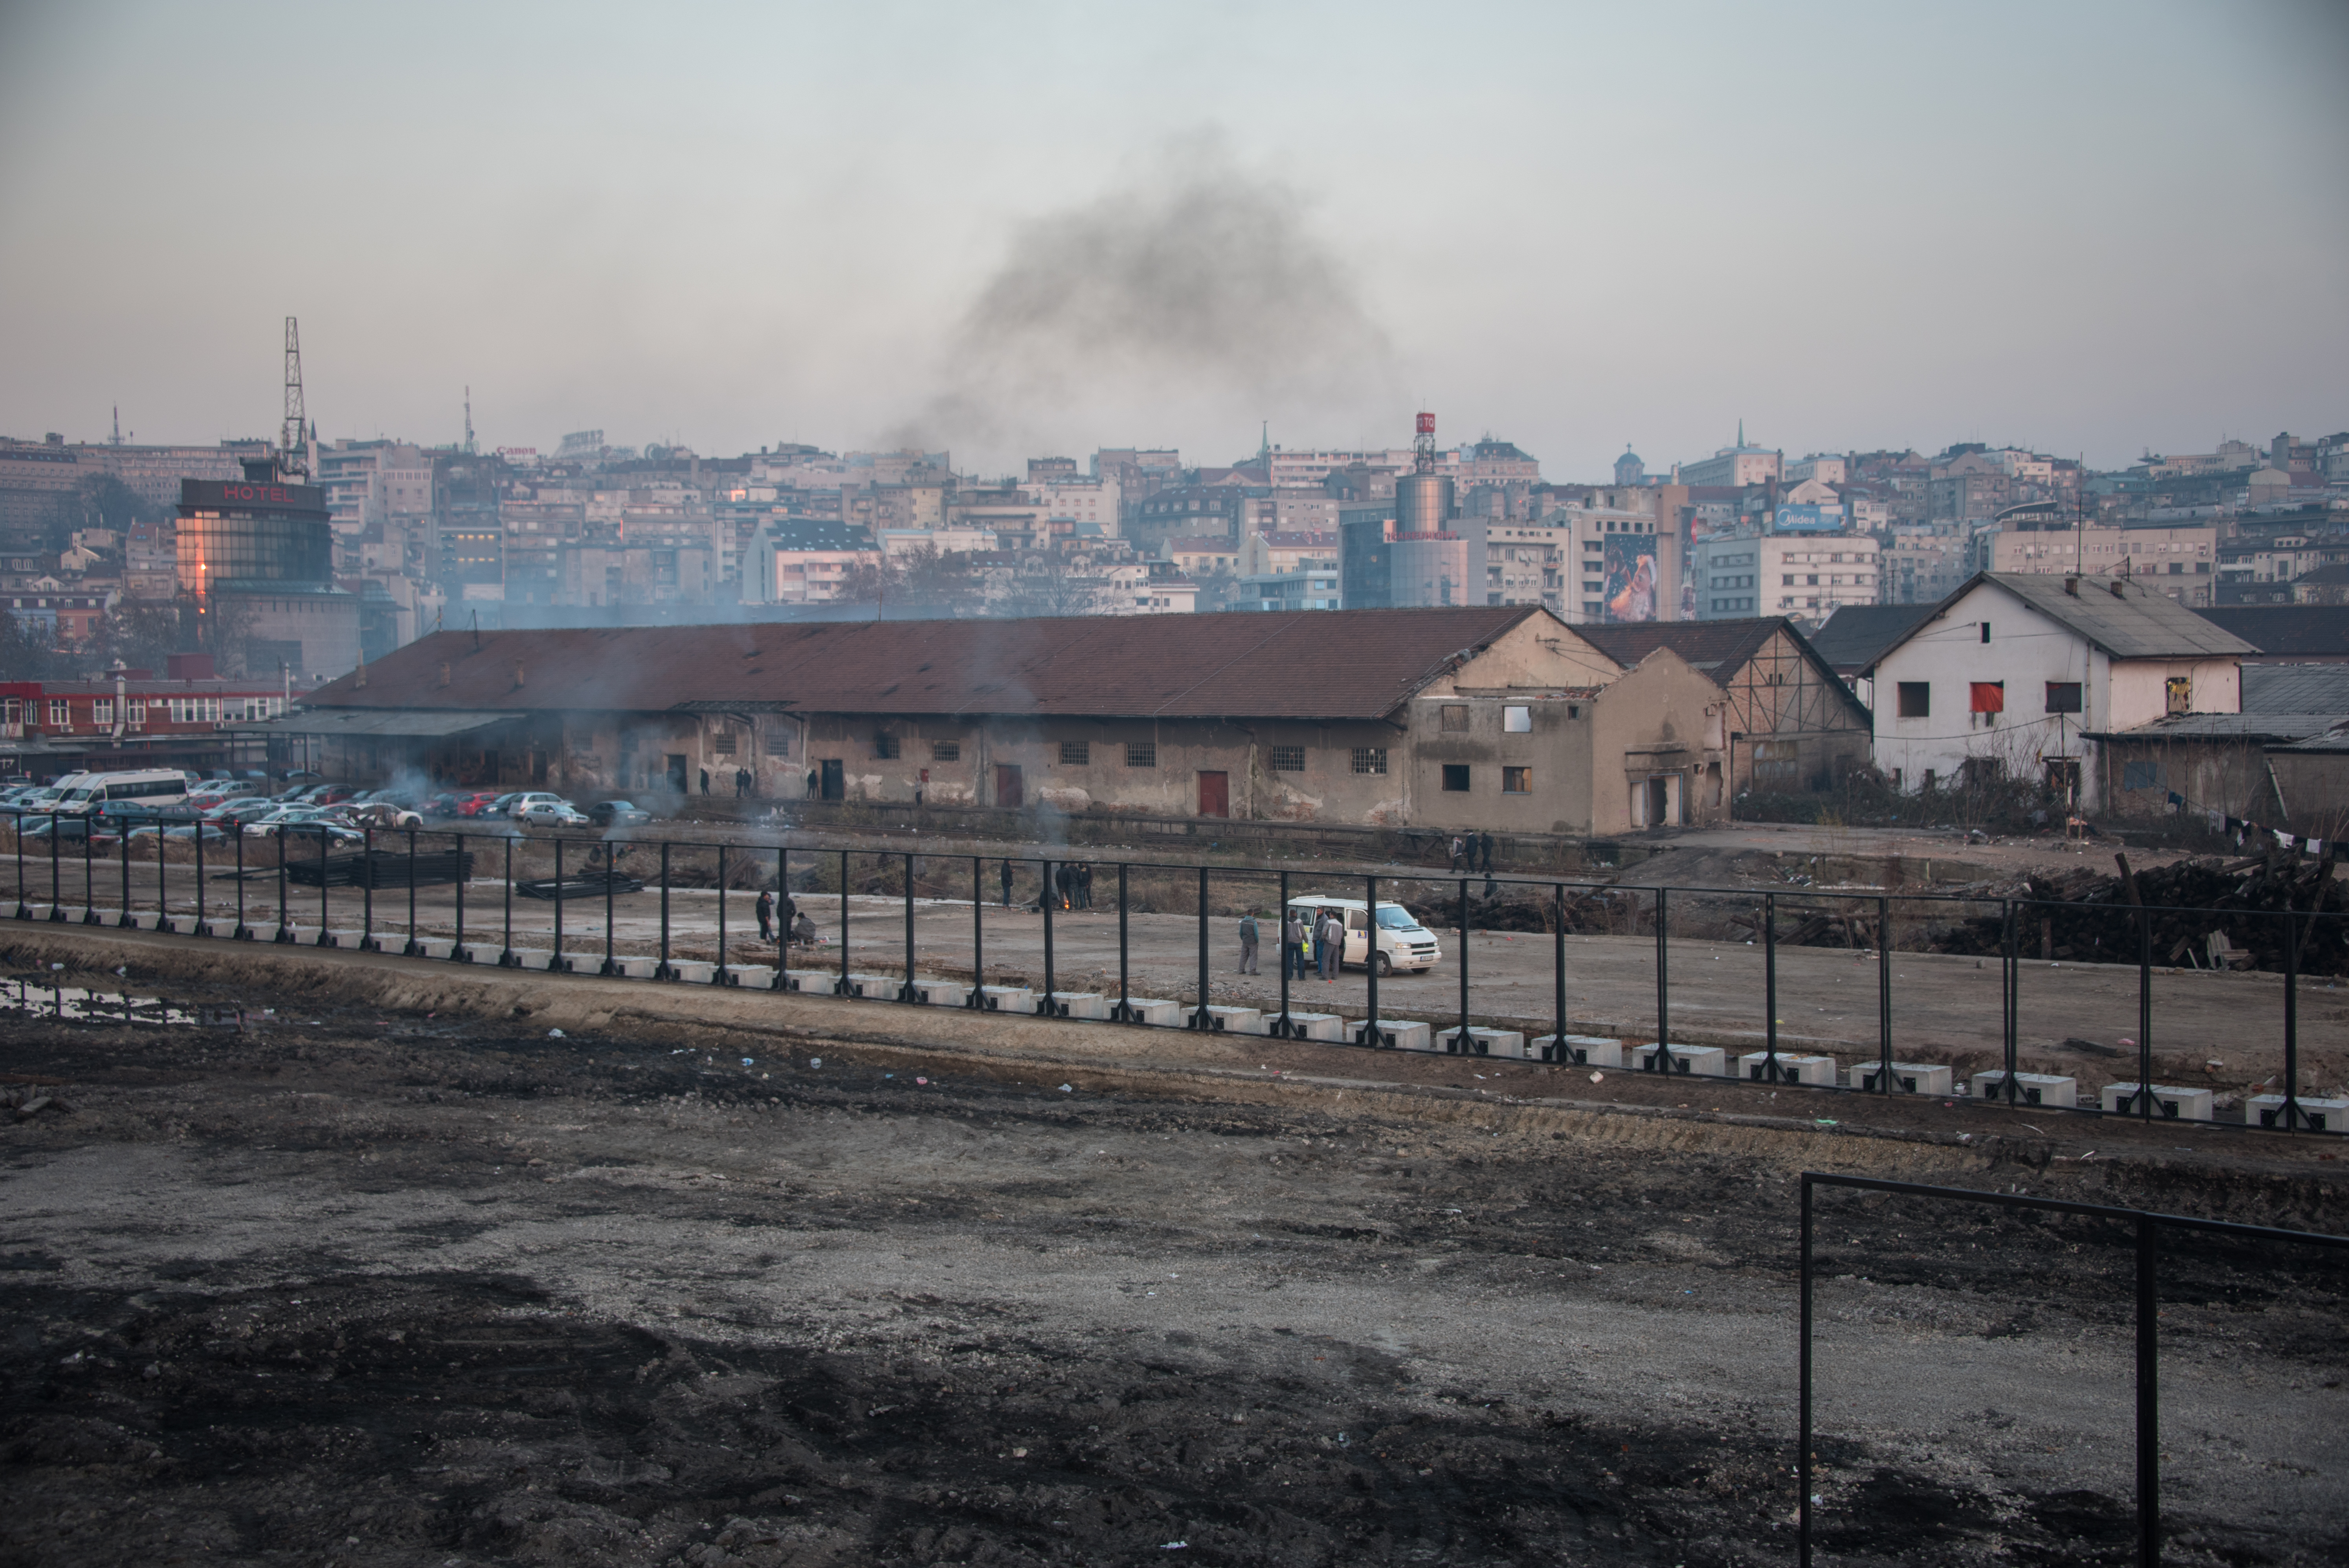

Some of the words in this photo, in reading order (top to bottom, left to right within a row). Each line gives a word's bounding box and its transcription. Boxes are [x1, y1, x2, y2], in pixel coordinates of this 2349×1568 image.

[1424, 418, 1434, 428] TQ
[497, 446, 536, 455] Canon
[224, 485, 294, 502] HOTEL
[1782, 514, 1815, 525] Midea
[1385, 531, 1457, 541] TRADEUNIQUE
